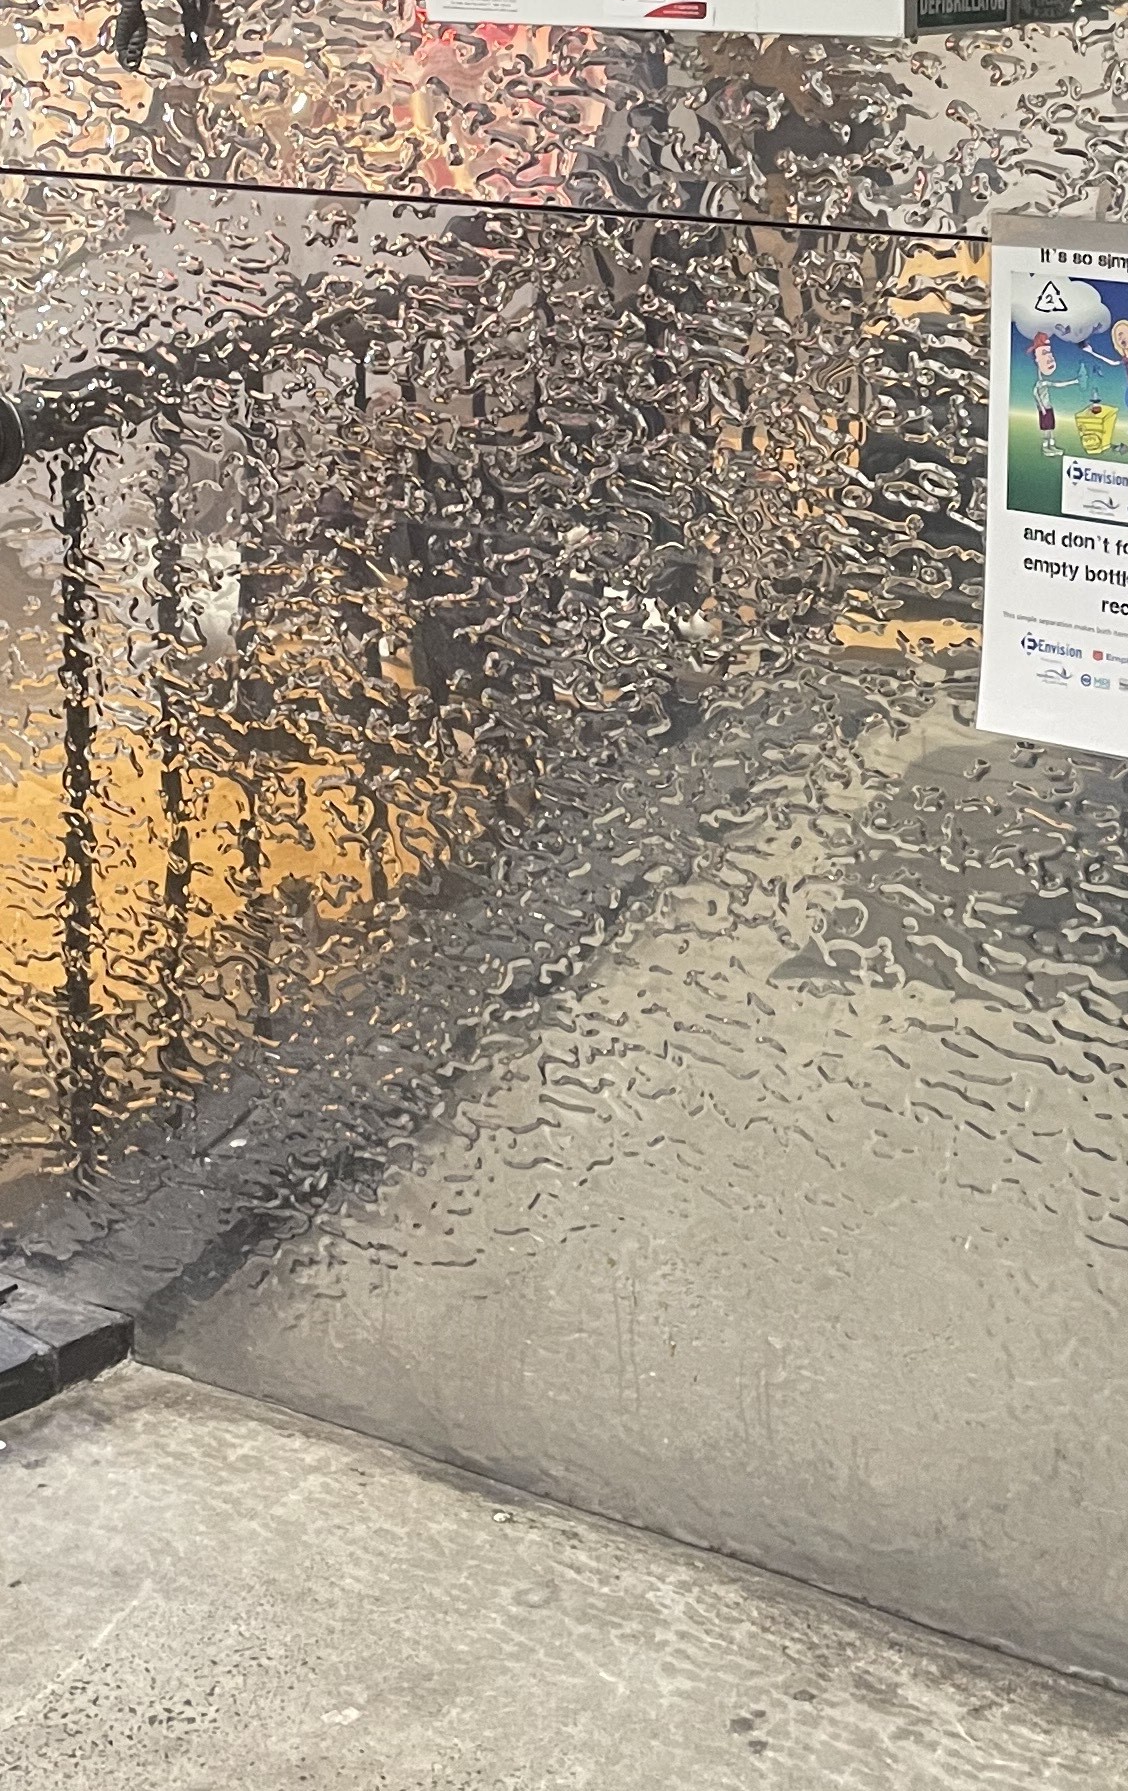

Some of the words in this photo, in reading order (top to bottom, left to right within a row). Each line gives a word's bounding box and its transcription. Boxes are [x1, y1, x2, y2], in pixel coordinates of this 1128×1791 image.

[1039, 247, 1068, 265] It's
[1072, 252, 1093, 266] so
[1084, 466, 1128, 488] Envision
[1023, 526, 1056, 547] and
[1061, 531, 1110, 555] don't
[1023, 557, 1079, 582] empty
[1037, 638, 1083, 660] Envision
